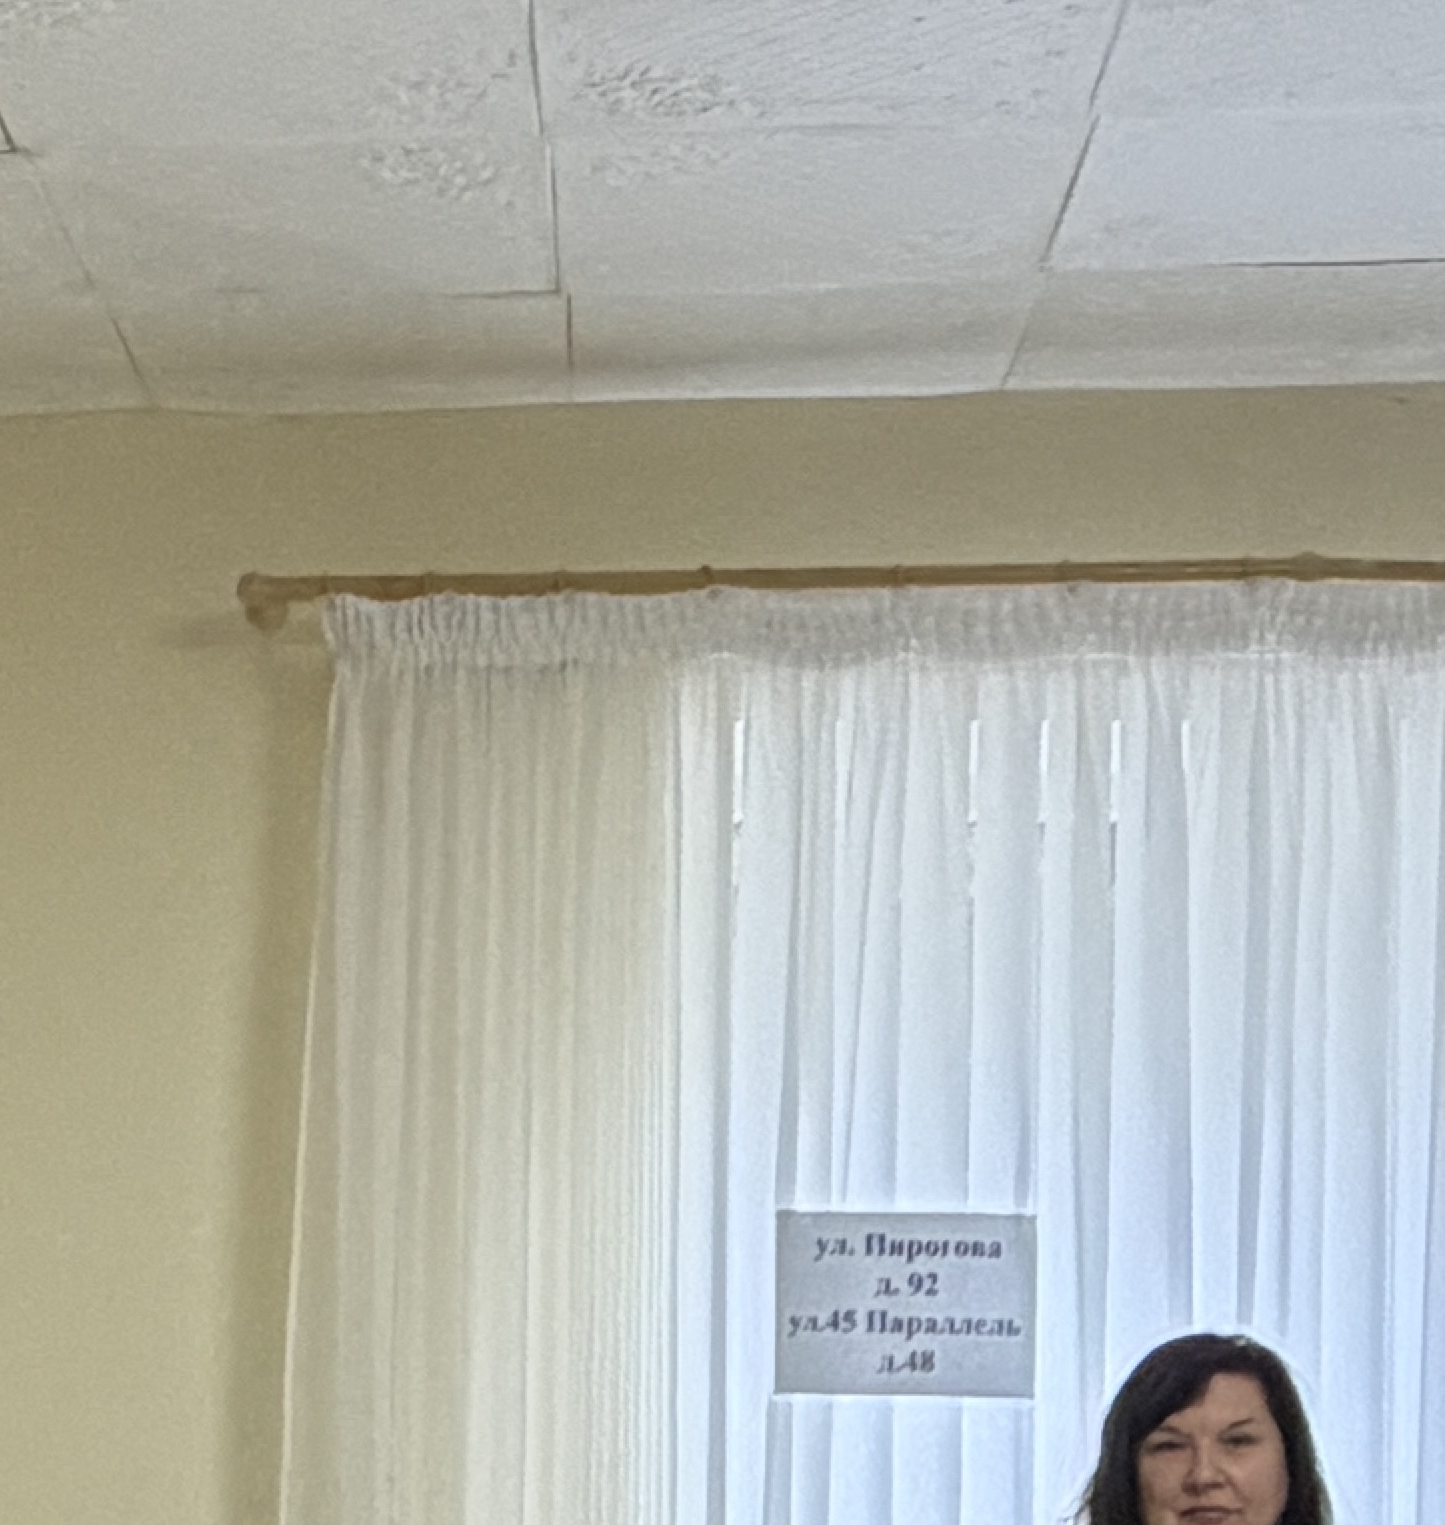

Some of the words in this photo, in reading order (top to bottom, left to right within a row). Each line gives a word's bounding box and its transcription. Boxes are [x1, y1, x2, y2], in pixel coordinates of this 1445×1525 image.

[813, 1237, 855, 1262] ул.
[865, 1233, 1002, 1263] Пирогова
[907, 1272, 939, 1297] 92
[865, 1310, 1022, 1341] Параллель
